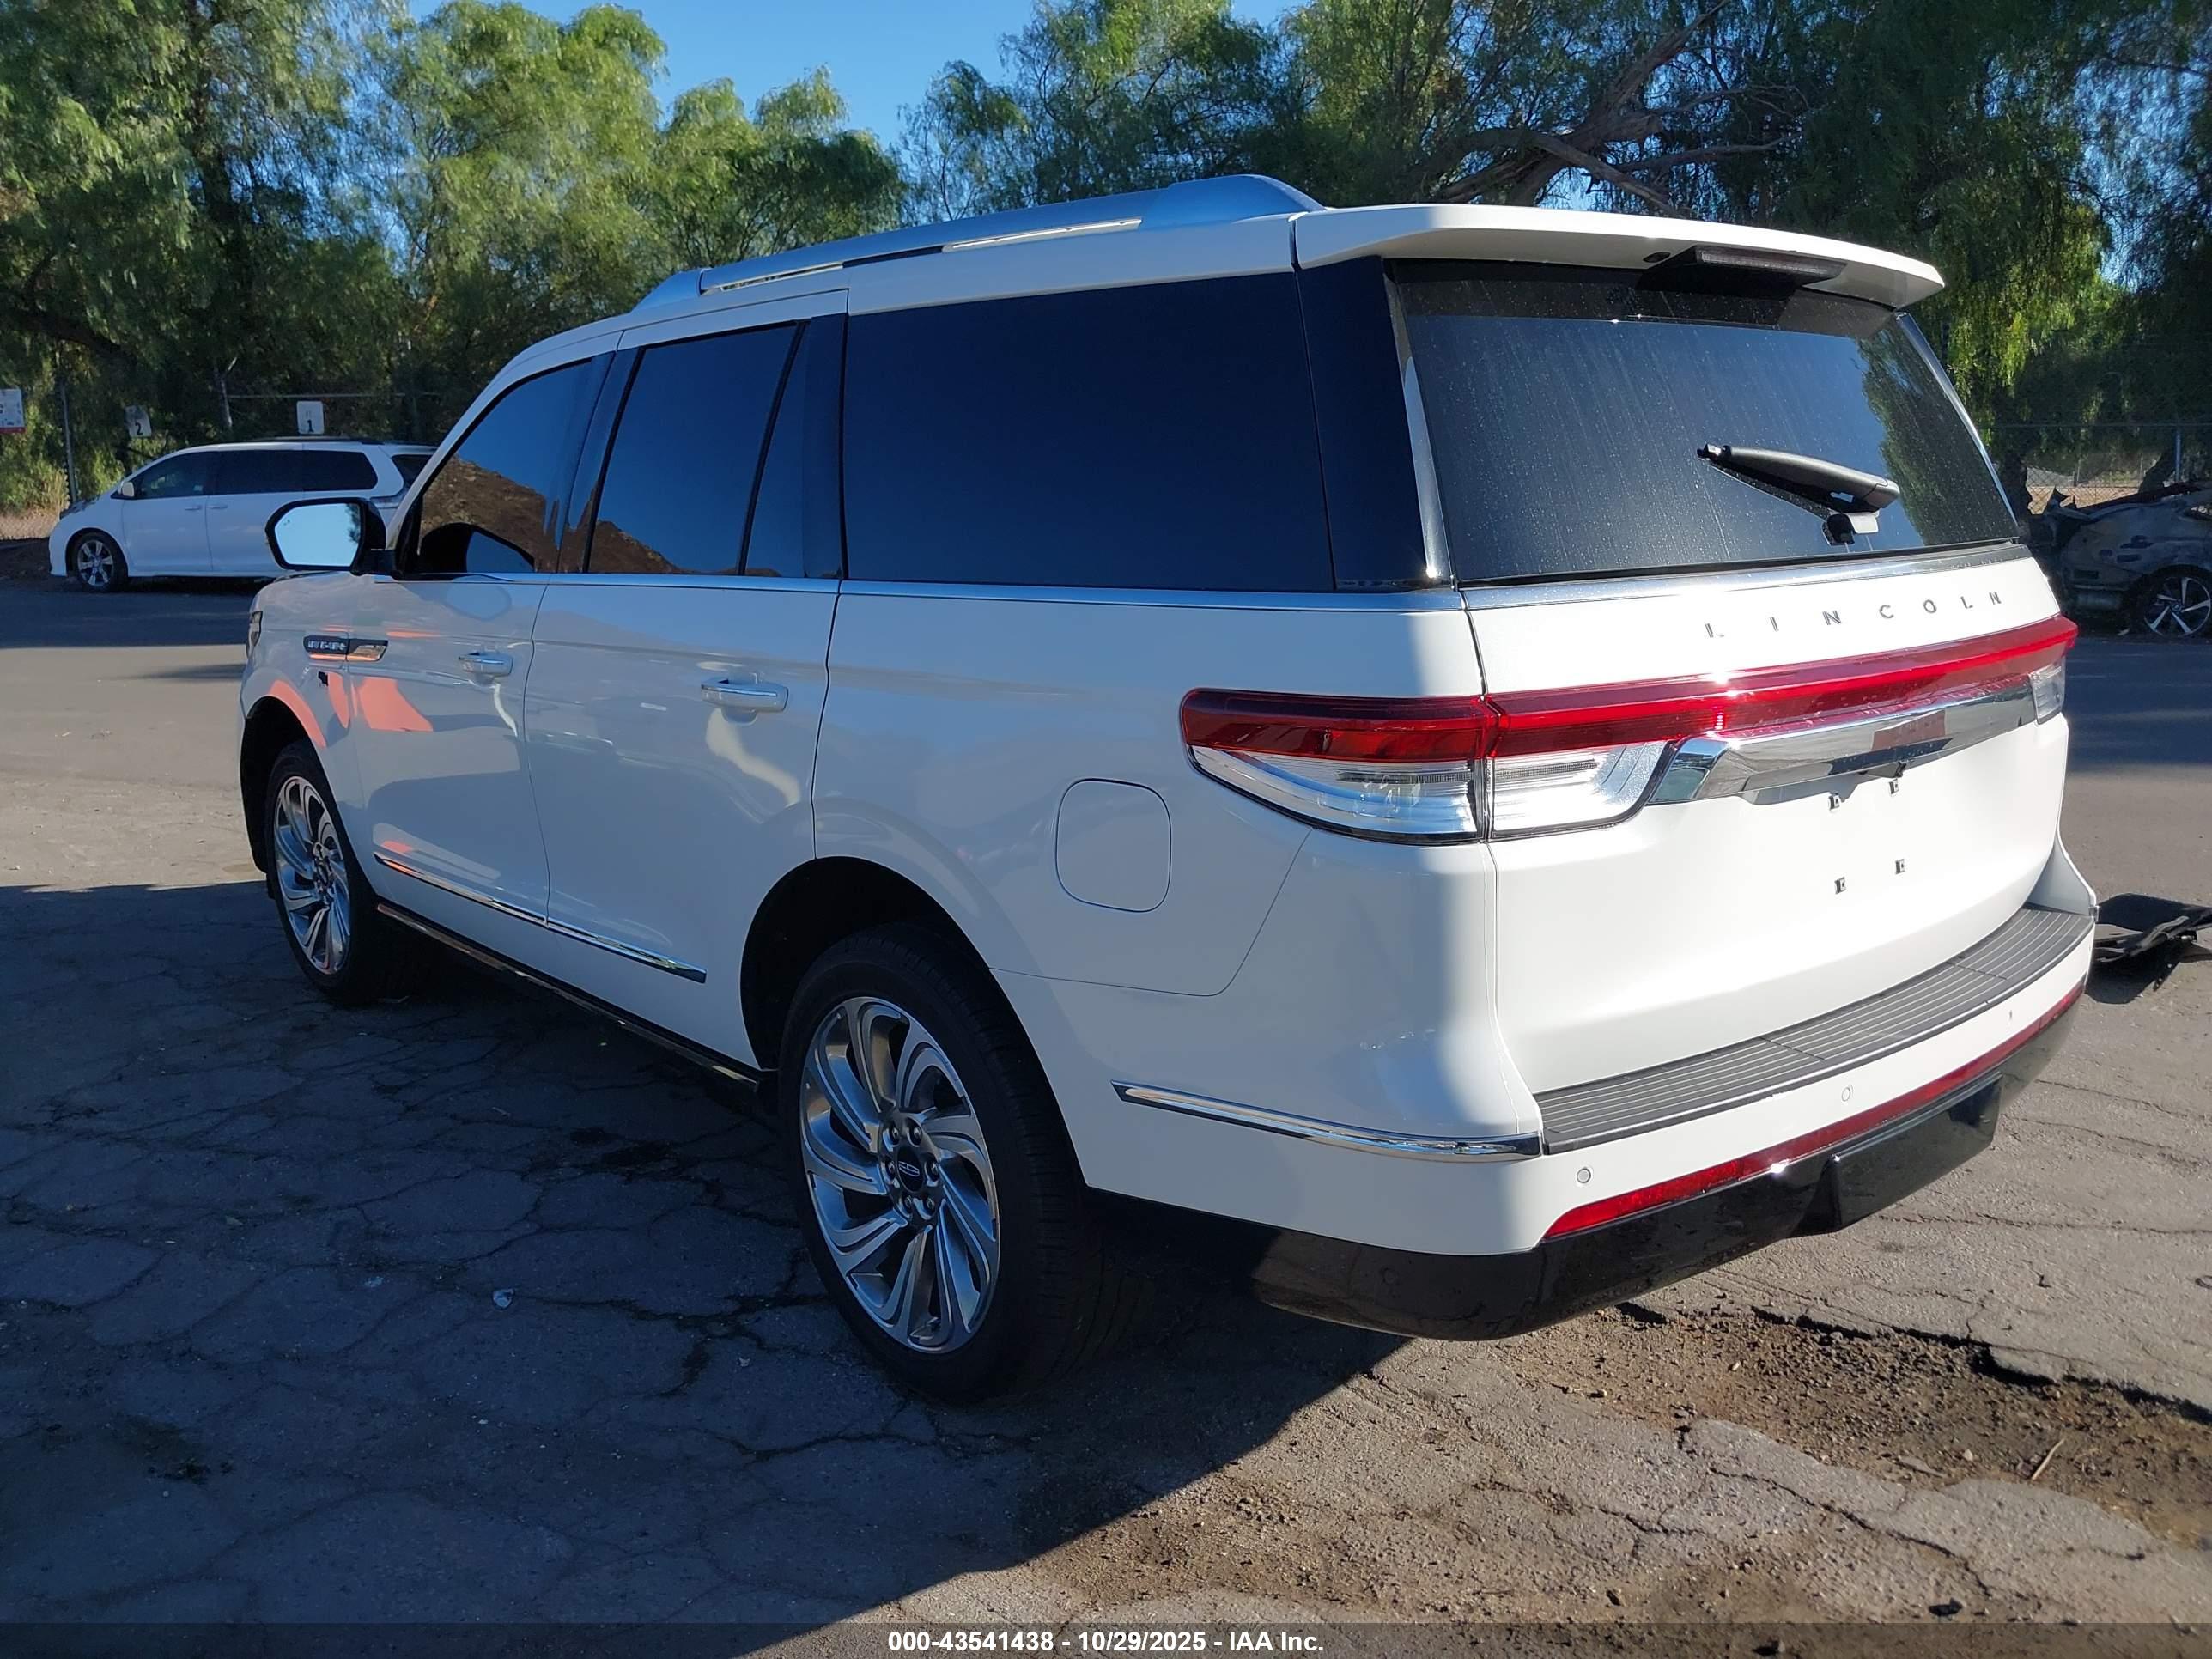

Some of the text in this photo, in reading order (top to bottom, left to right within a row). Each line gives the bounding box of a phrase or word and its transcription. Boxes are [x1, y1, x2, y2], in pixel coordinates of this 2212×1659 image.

[135, 422, 143, 435] 2
[307, 419, 314, 433] 1
[1705, 591, 2002, 639] LINCOLN
